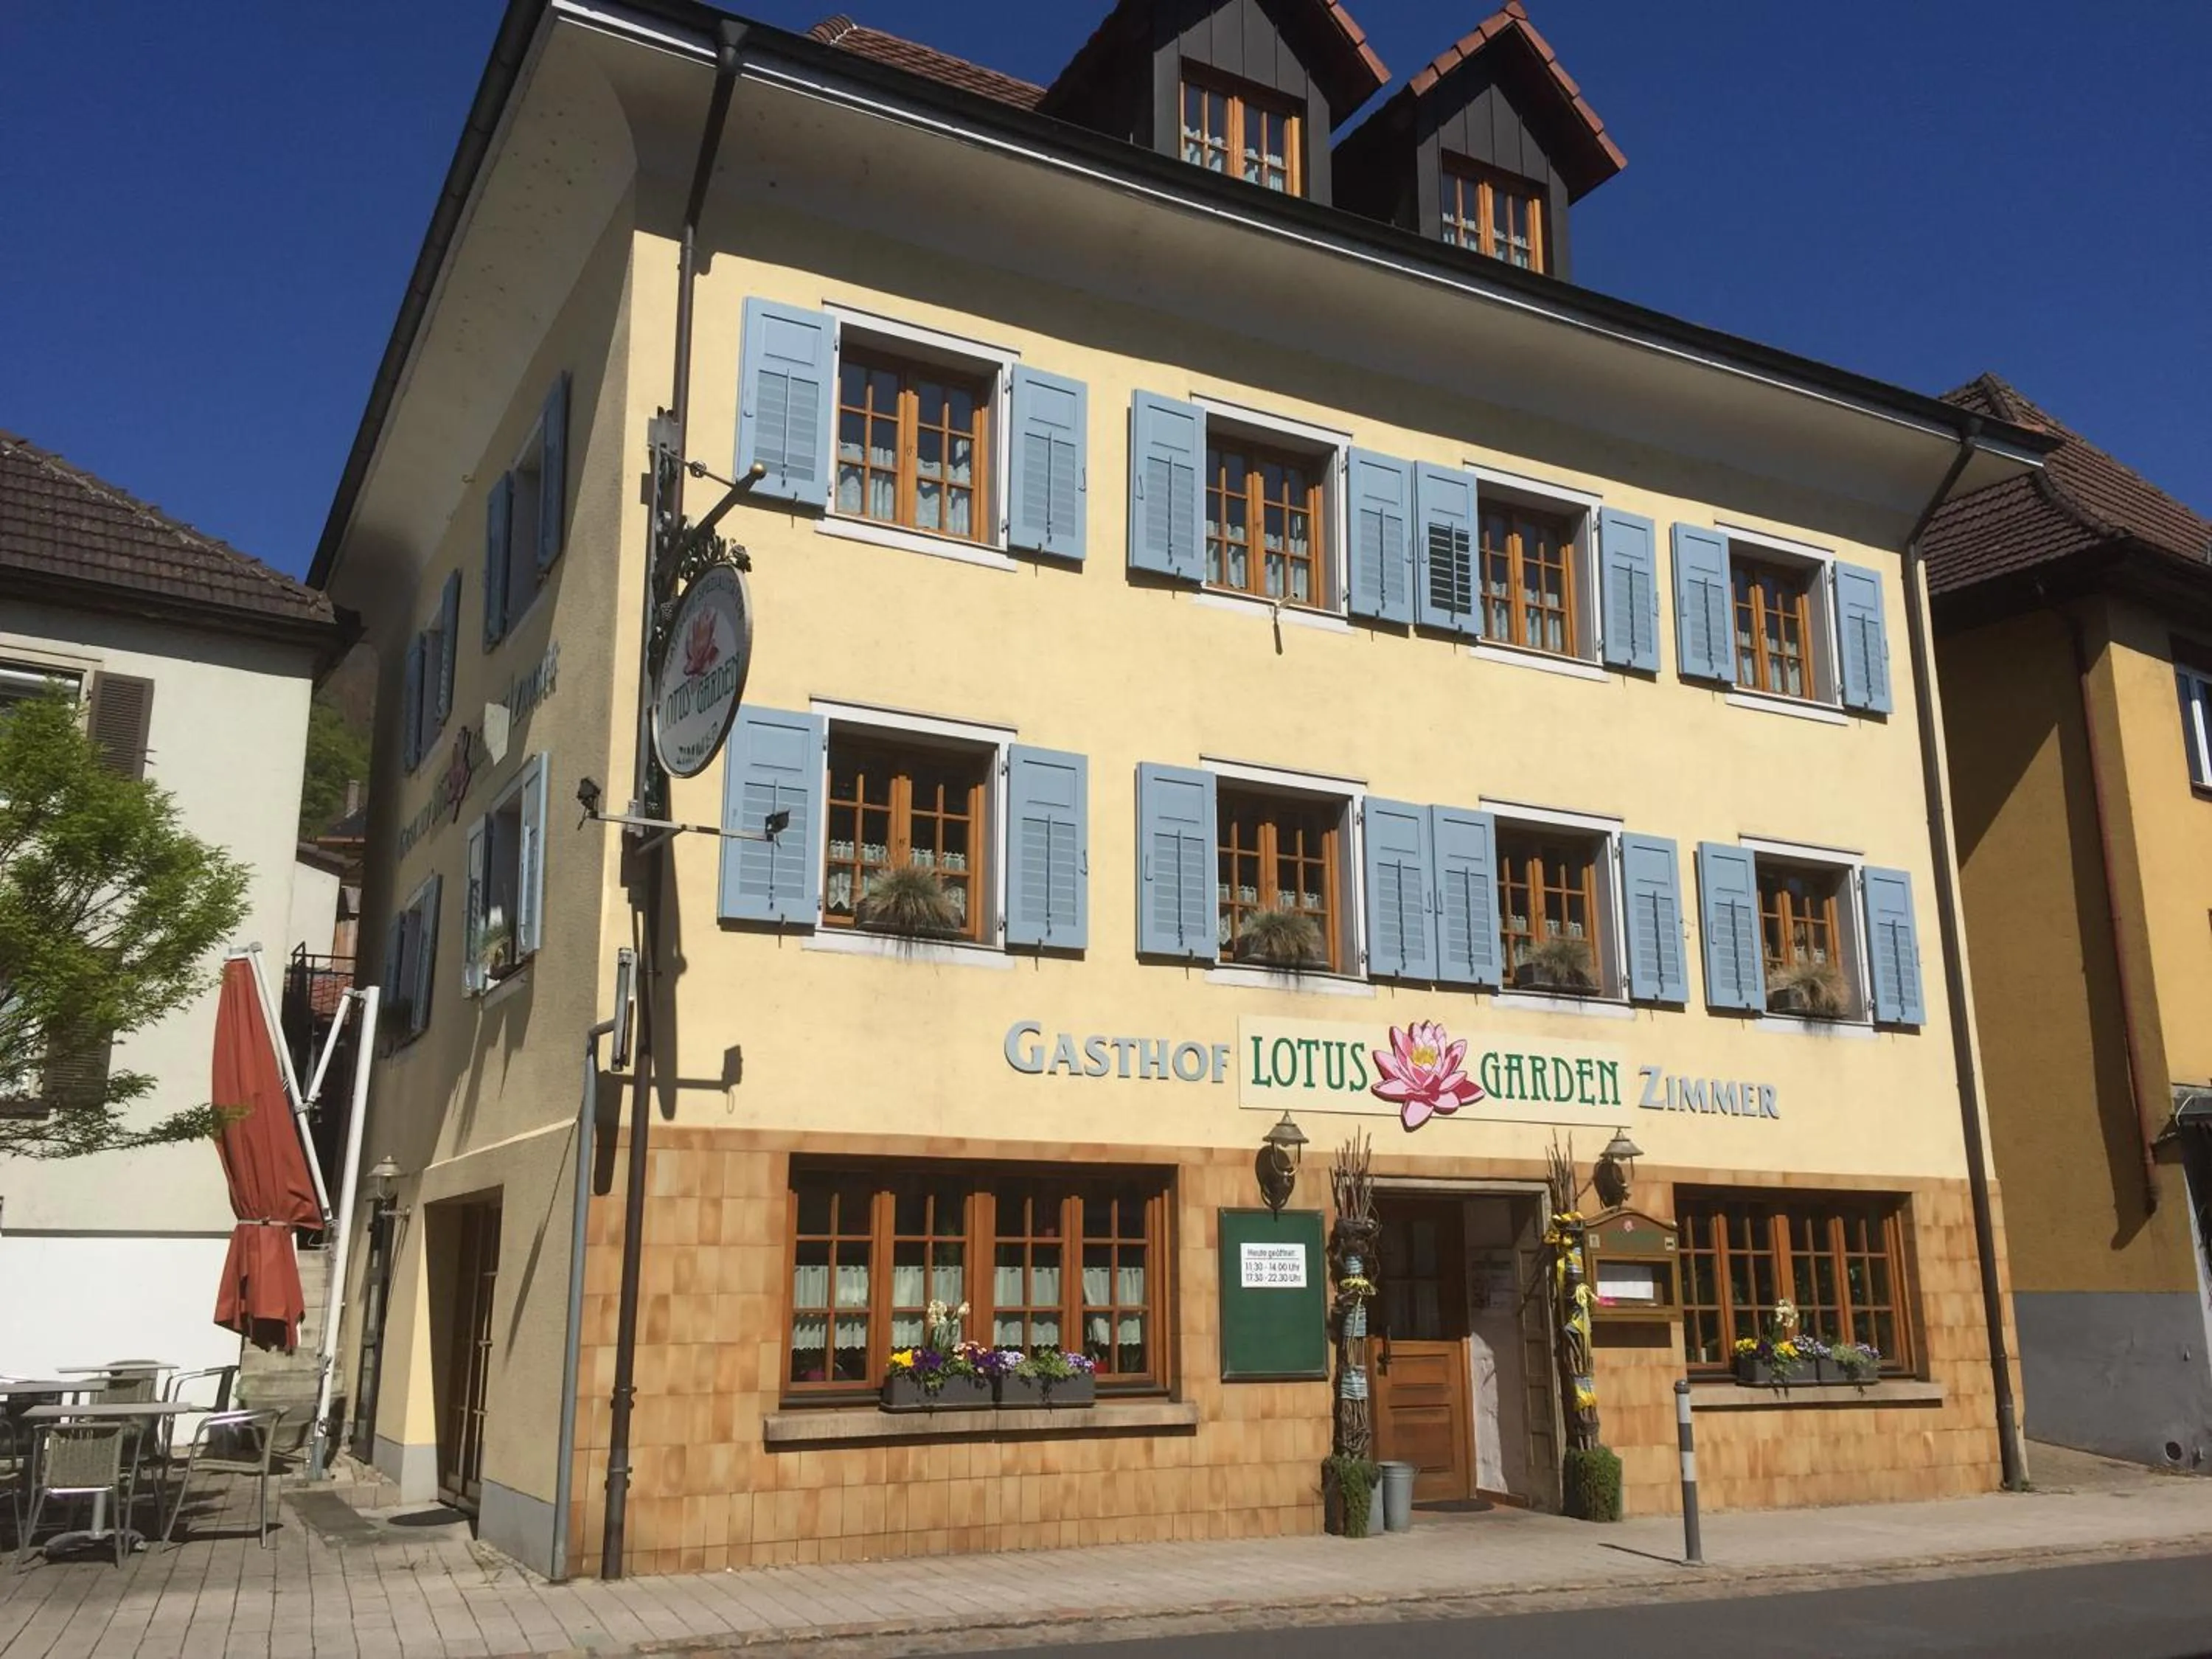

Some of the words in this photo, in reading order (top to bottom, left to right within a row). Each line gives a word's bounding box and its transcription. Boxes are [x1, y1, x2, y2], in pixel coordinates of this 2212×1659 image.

[696, 650, 740, 714] GARDEN
[1004, 1020, 1230, 1083] GASTHOF
[1250, 1035, 1368, 1091] LOTUS
[1481, 1051, 1621, 1105] GARDEN
[1638, 1065, 1780, 1119] ZIMMER
